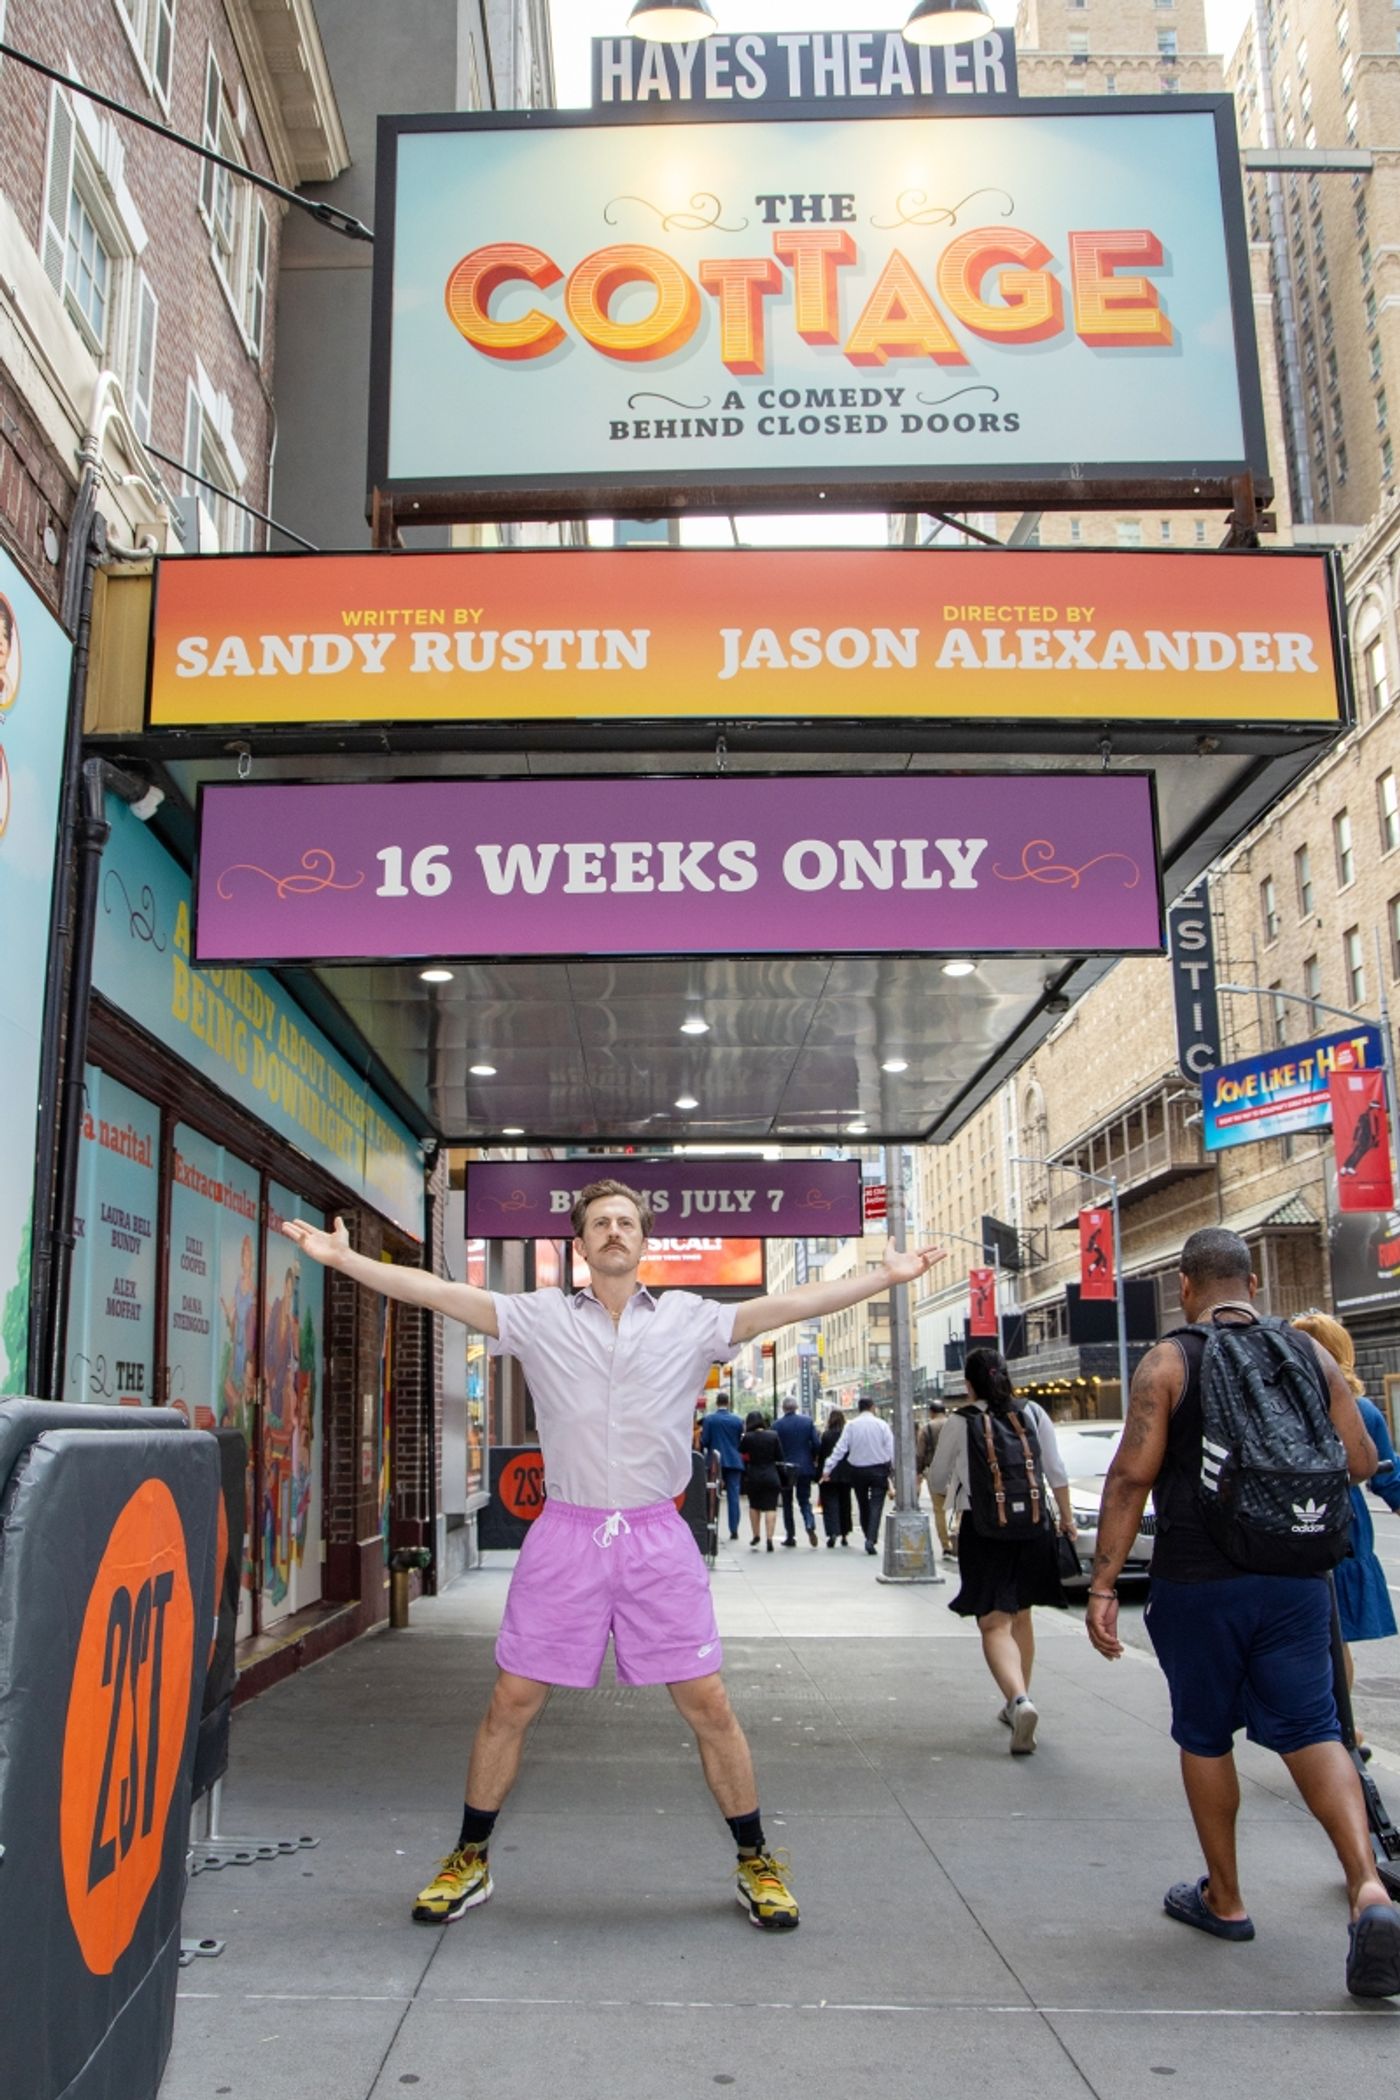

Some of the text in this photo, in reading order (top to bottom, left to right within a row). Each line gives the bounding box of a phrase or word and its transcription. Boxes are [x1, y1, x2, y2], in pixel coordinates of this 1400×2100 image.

[602, 31, 1007, 101] HAYES THEATER
[755, 194, 857, 225] THE
[444, 227, 1173, 376] COTTAGE
[722, 387, 906, 411] A COMEDY
[608, 412, 1021, 441] BEHIND CLOSED DOORS
[341, 608, 485, 627] WRITTEN BY
[942, 605, 1096, 623] DIRECTED BY
[175, 628, 651, 678] SANDY RUSTIN
[718, 627, 1319, 679] JASON ALEXANDER
[375, 838, 988, 897] 16 WEEKS ONLY
[1174, 882, 1217, 1074] ESTIC
[203, 968, 277, 1041] MEDY
[278, 1014, 325, 1092] ABOUT
[172, 953, 354, 1167] BEING DOWNRIGHT
[1213, 1075, 1258, 1108] SOME
[680, 1190, 756, 1217] JULY
[767, 1190, 784, 1212] 7
[101, 1203, 131, 1232] LAURA
[133, 1214, 152, 1237] BELL
[111, 1230, 142, 1254] BUNDY
[646, 1238, 722, 1251] SICAL!
[180, 1254, 206, 1276] COOPER
[113, 1277, 137, 1299] ALEX
[106, 1297, 142, 1321] MOFFAT
[182, 1295, 203, 1315] DANA
[116, 1361, 144, 1390] THE
[513, 1467, 547, 1506] 2S
[1291, 1523, 1325, 1533] adidas
[88, 1571, 174, 1896] 2ST
